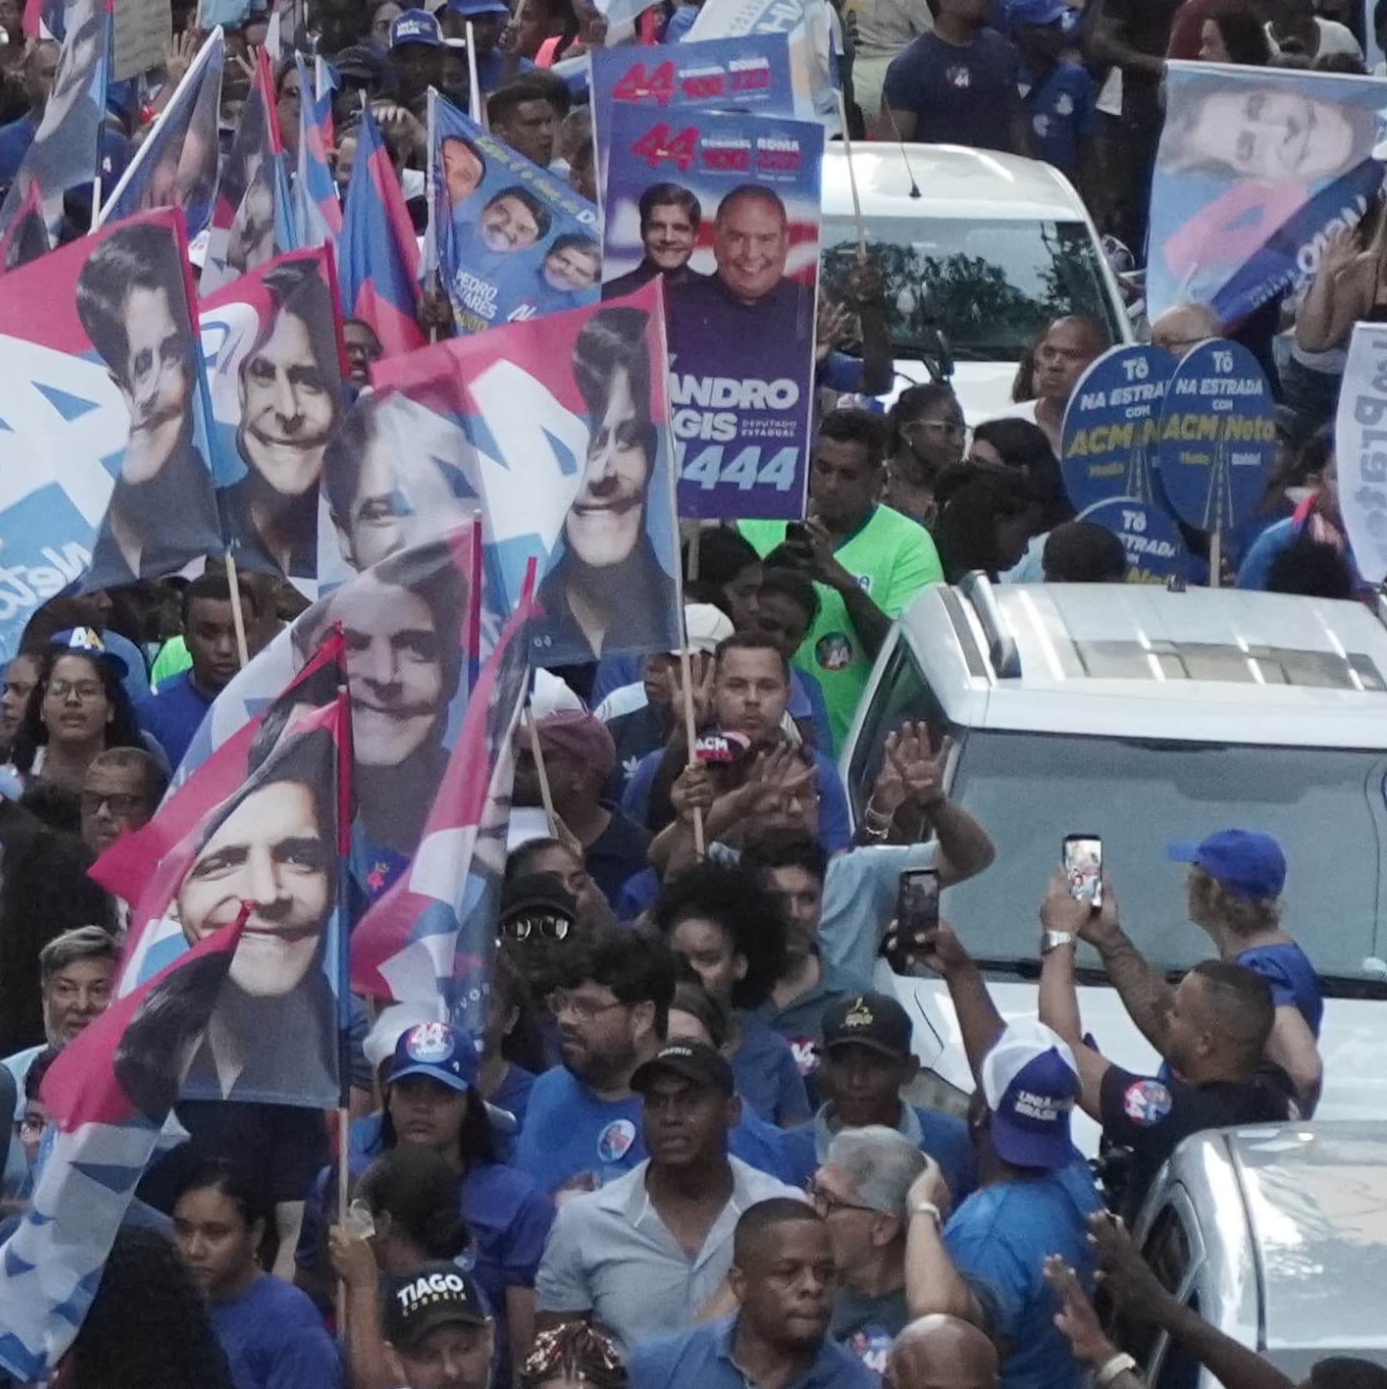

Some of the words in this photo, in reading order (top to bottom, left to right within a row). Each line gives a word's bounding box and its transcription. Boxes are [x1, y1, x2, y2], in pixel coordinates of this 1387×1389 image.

[632, 122, 700, 171] 44
[757, 138, 800, 152] ROMA
[670, 376, 799, 411] ANDRO
[1080, 391, 1107, 412] NA
[1110, 381, 1171, 407] ESTRA
[1176, 378, 1198, 395] NA
[1200, 379, 1263, 396] ESTRADA
[740, 418, 798, 429] DEPUTADO
[740, 428, 796, 438] ESTADUAL
[1164, 414, 1219, 441] ACM
[1067, 422, 1135, 459] ACM
[396, 1273, 465, 1308] TIAGO
